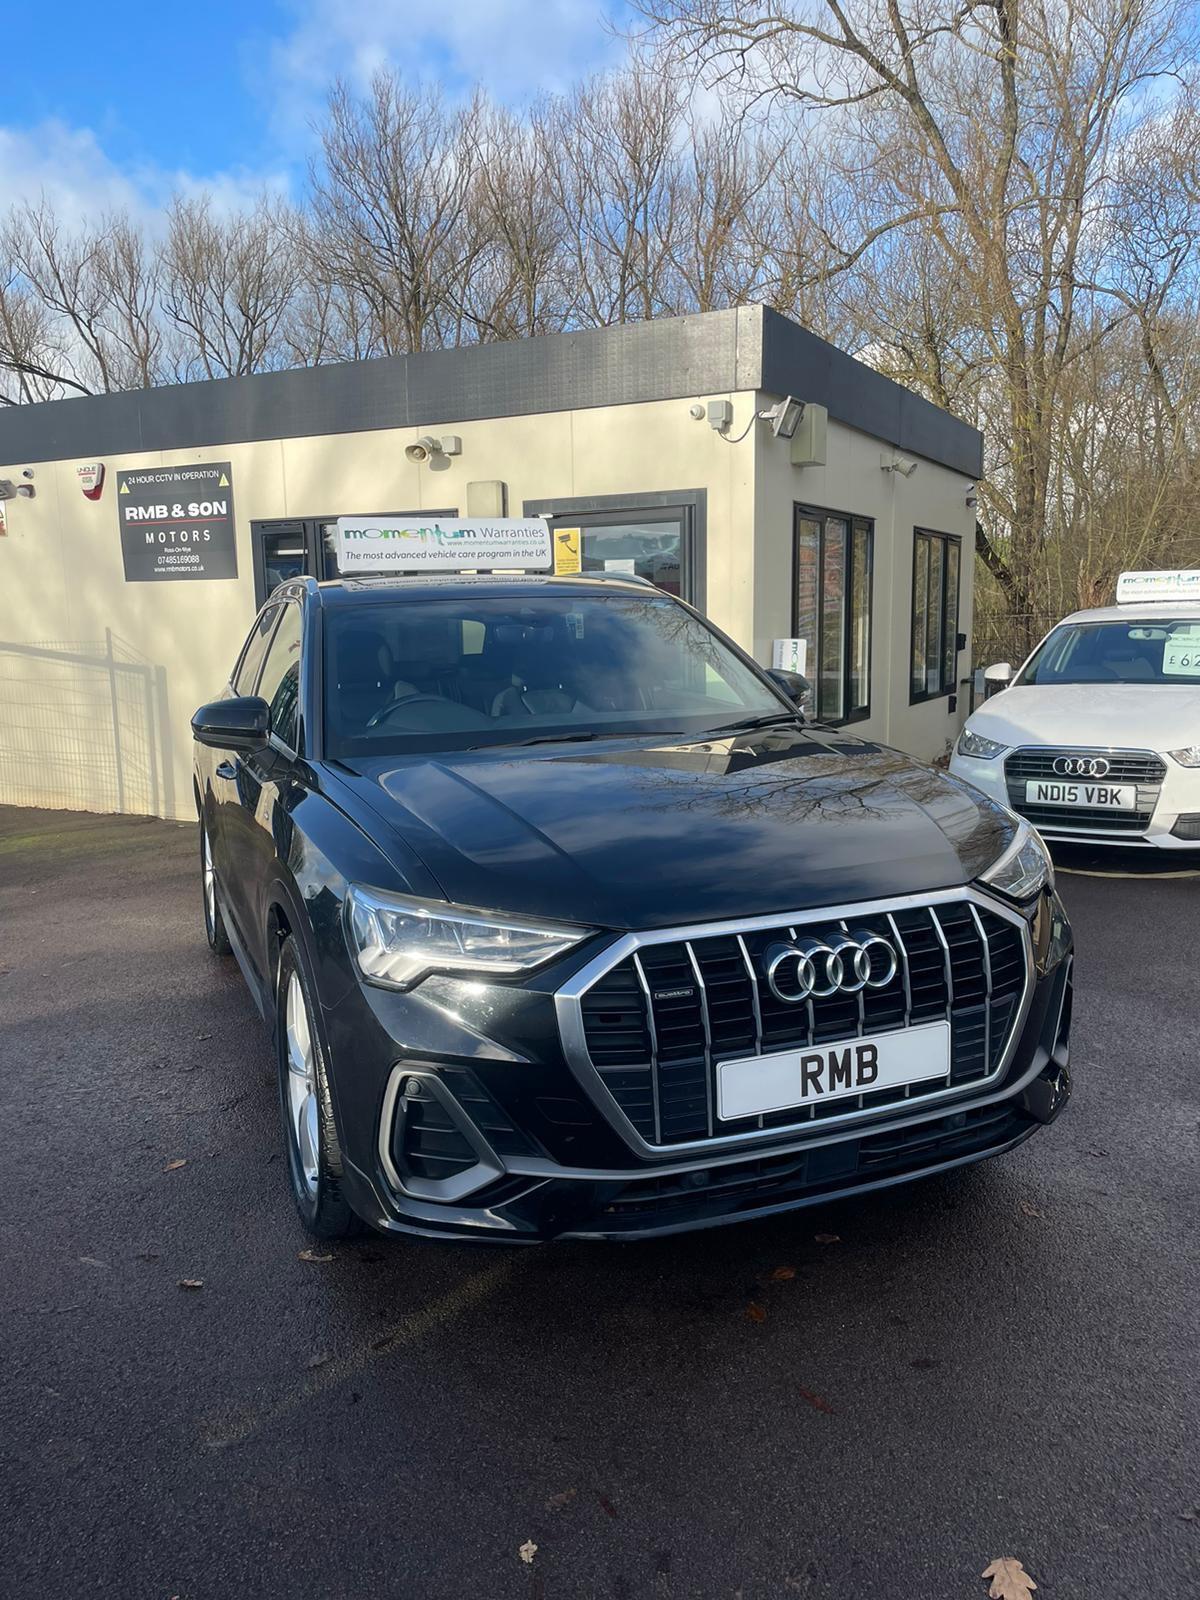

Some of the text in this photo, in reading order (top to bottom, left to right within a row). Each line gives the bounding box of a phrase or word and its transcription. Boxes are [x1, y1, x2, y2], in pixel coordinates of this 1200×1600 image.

[128, 470, 219, 485] 24 HOUR CCTV IN OPERATION
[125, 501, 227, 520] RMB & SON
[145, 529, 211, 544] MOTORS
[344, 523, 545, 546] momentum Warranties
[346, 551, 361, 560] The
[362, 551, 384, 560] most
[385, 550, 427, 559] advanced
[428, 550, 456, 559] vehicle
[476, 550, 512, 559] program
[512, 549, 520, 558] in
[521, 549, 534, 557] the
[535, 549, 547, 557] UK
[1037, 784, 1122, 805] ND15 VBK
[800, 1044, 878, 1097] RMB
